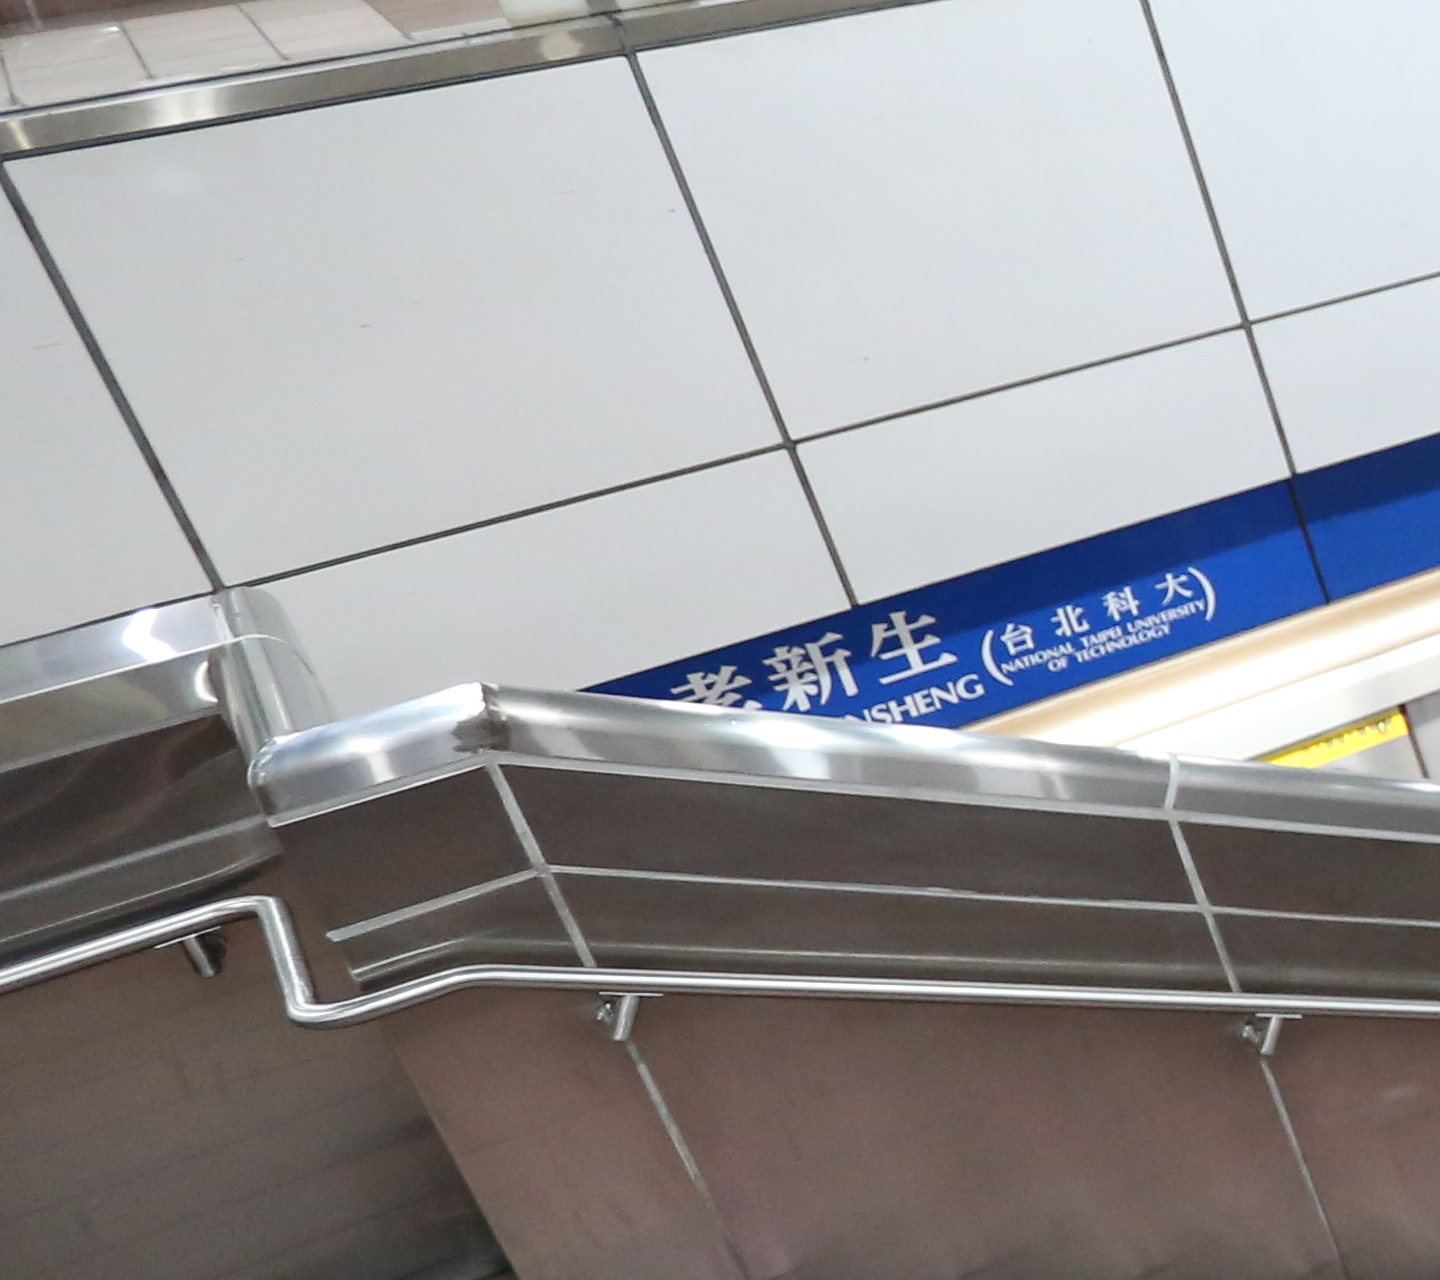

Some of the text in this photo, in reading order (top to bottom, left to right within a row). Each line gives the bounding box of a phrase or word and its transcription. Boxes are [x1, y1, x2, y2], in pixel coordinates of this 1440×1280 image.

[1000, 599, 1205, 674] NATIONAL TAIPEI UNIVERSITY
[1047, 624, 1171, 672] OF TECHNOLOGY
